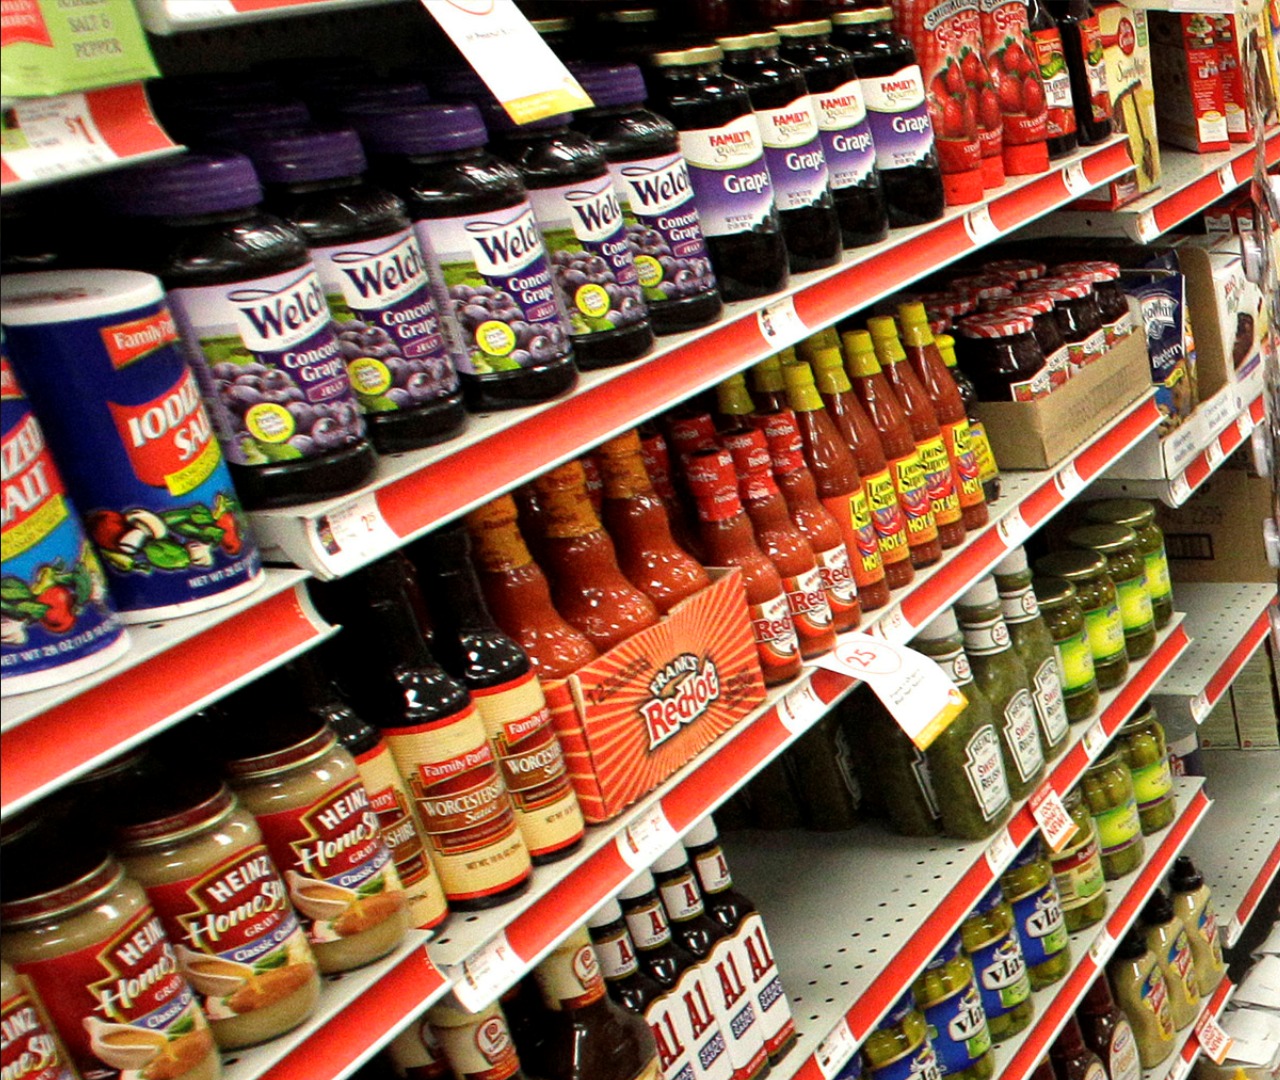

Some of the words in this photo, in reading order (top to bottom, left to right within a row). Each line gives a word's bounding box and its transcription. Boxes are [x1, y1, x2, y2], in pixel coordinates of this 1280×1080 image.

[892, 114, 930, 133] Grape
[832, 133, 871, 152] Grape
[786, 152, 824, 171] Grape
[724, 170, 768, 194] Grape
[650, 655, 699, 693] FRANK'S
[423, 756, 465, 780] Family
[316, 790, 368, 830] HEINZ
[206, 856, 271, 902] HEINZ
[244, 914, 280, 938] GRAVY
[233, 935, 273, 961] Classic
